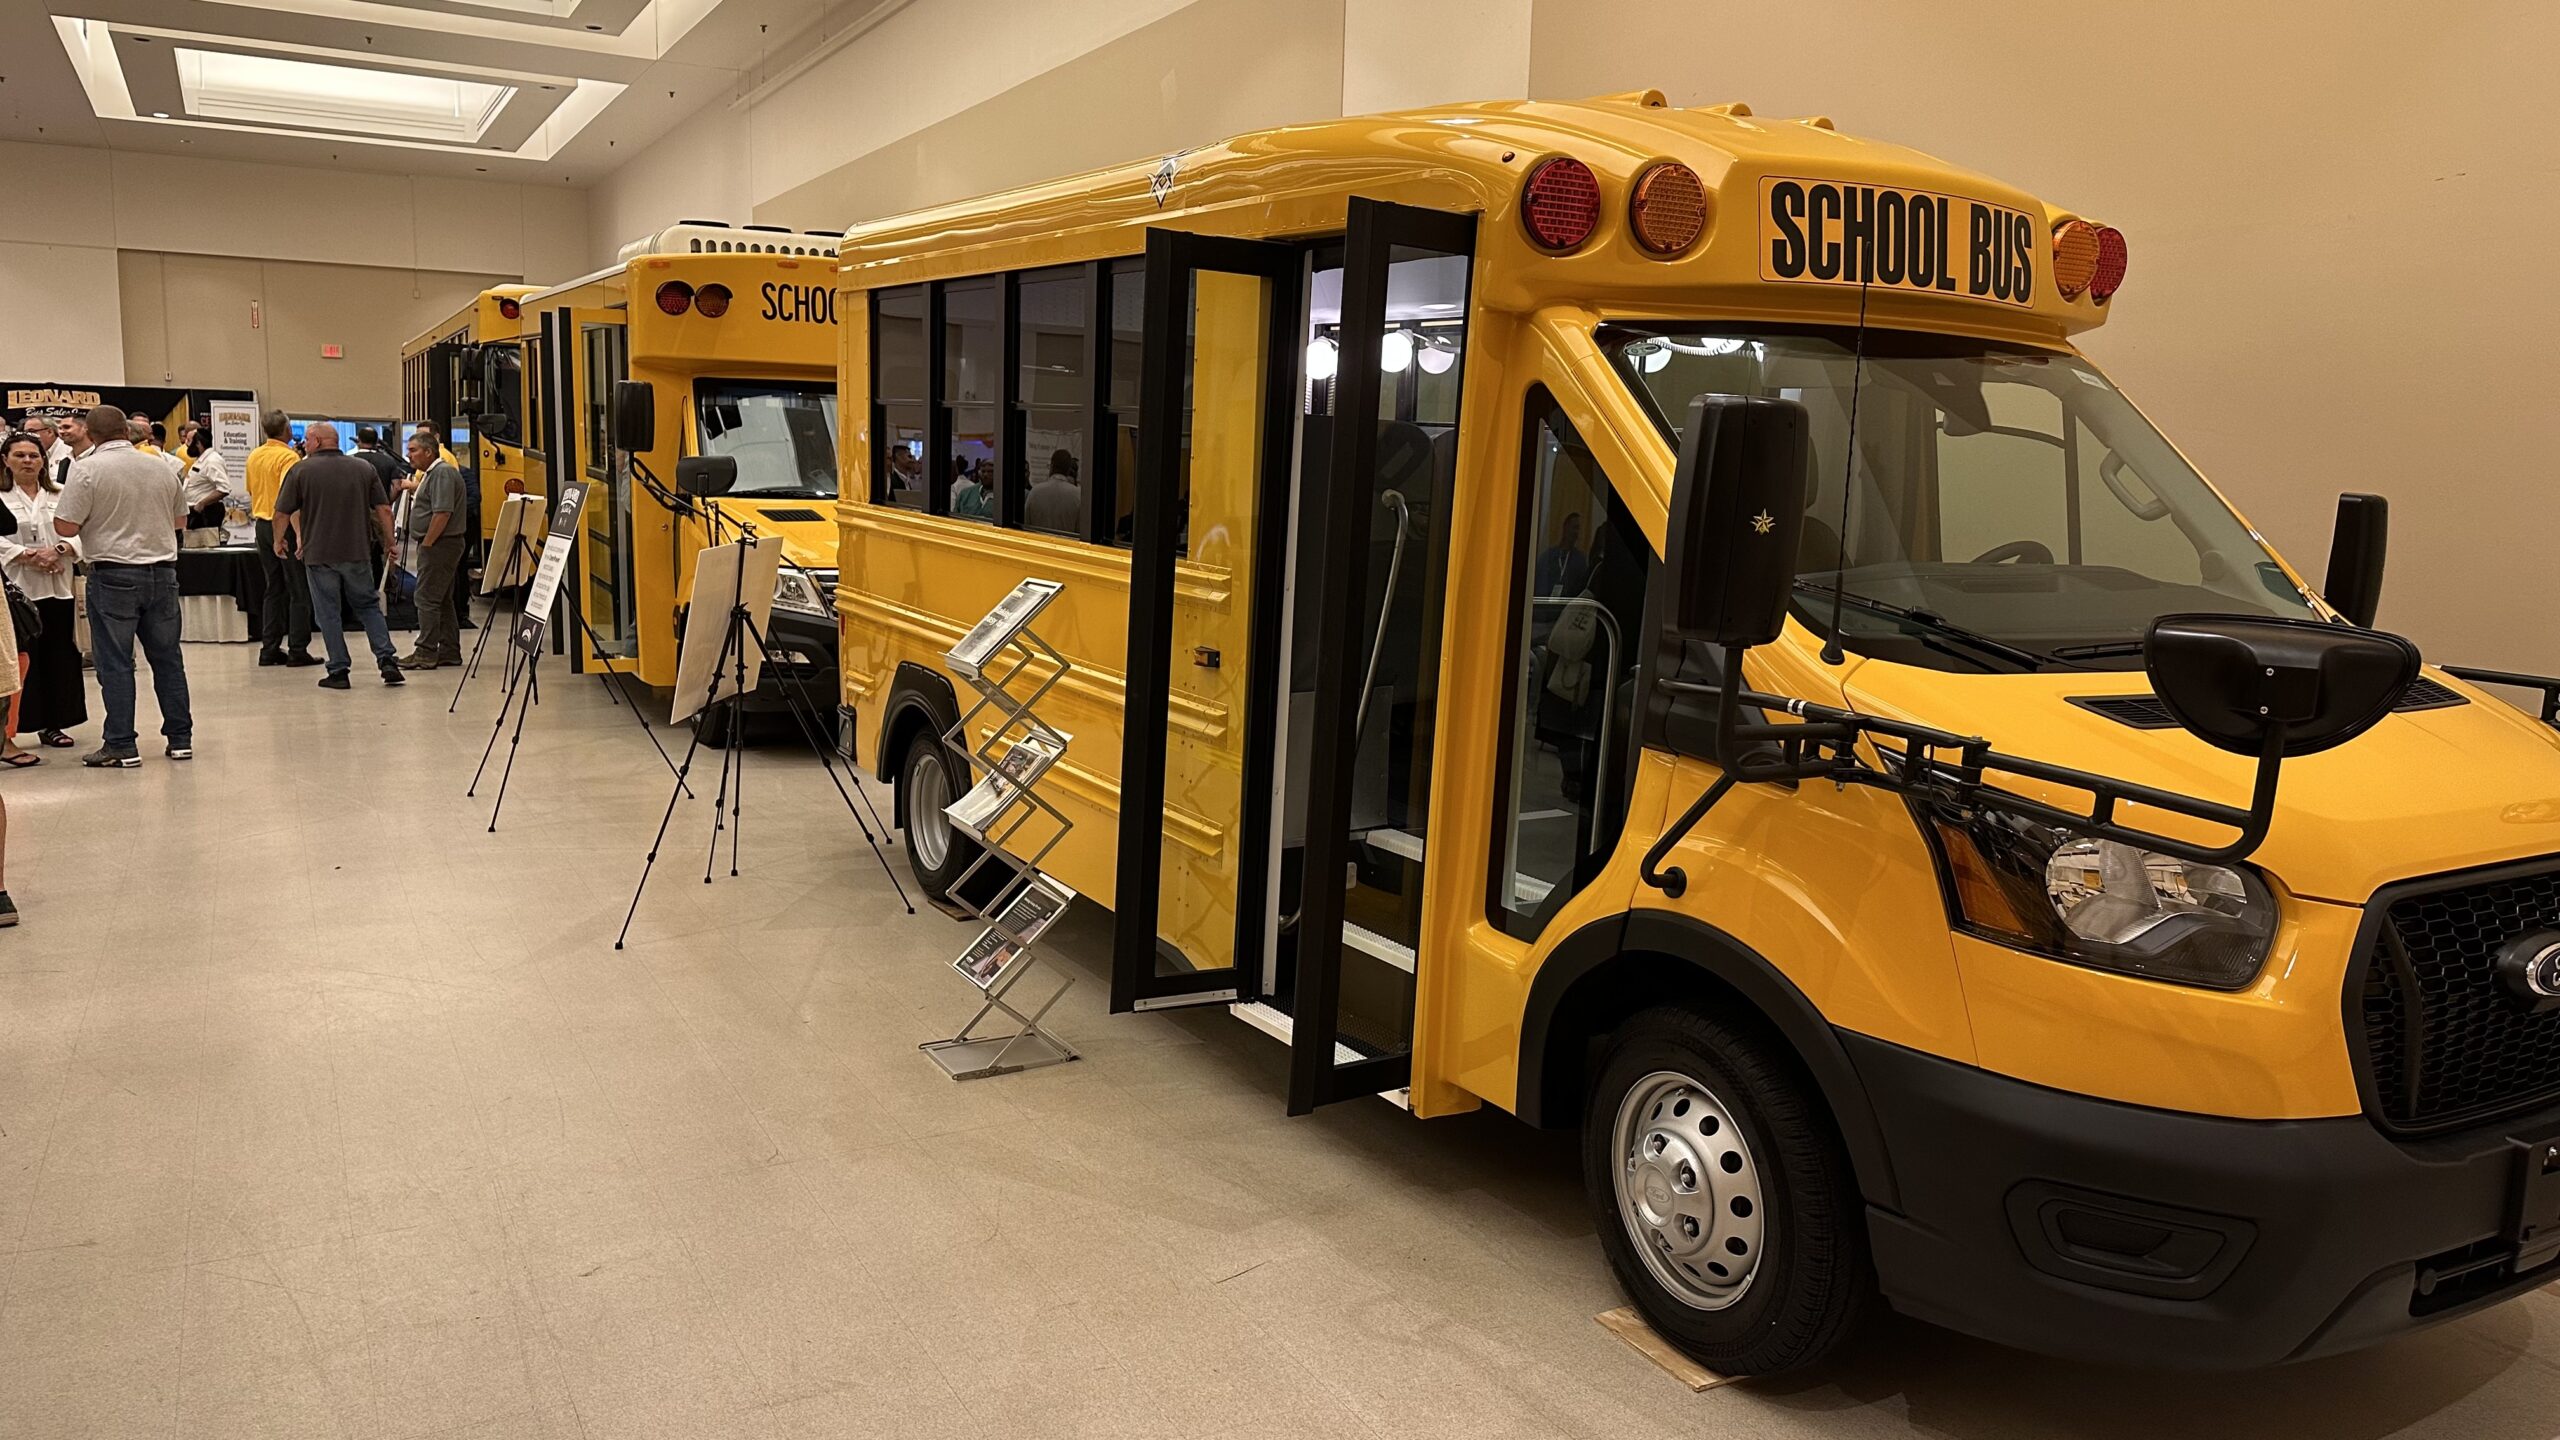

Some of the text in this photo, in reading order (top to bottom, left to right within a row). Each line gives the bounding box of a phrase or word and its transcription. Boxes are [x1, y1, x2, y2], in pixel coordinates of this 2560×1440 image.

[1771, 181, 2032, 303] SCHOOL BUS
[8, 389, 101, 409] LEONARD
[229, 438, 247, 446] Training
